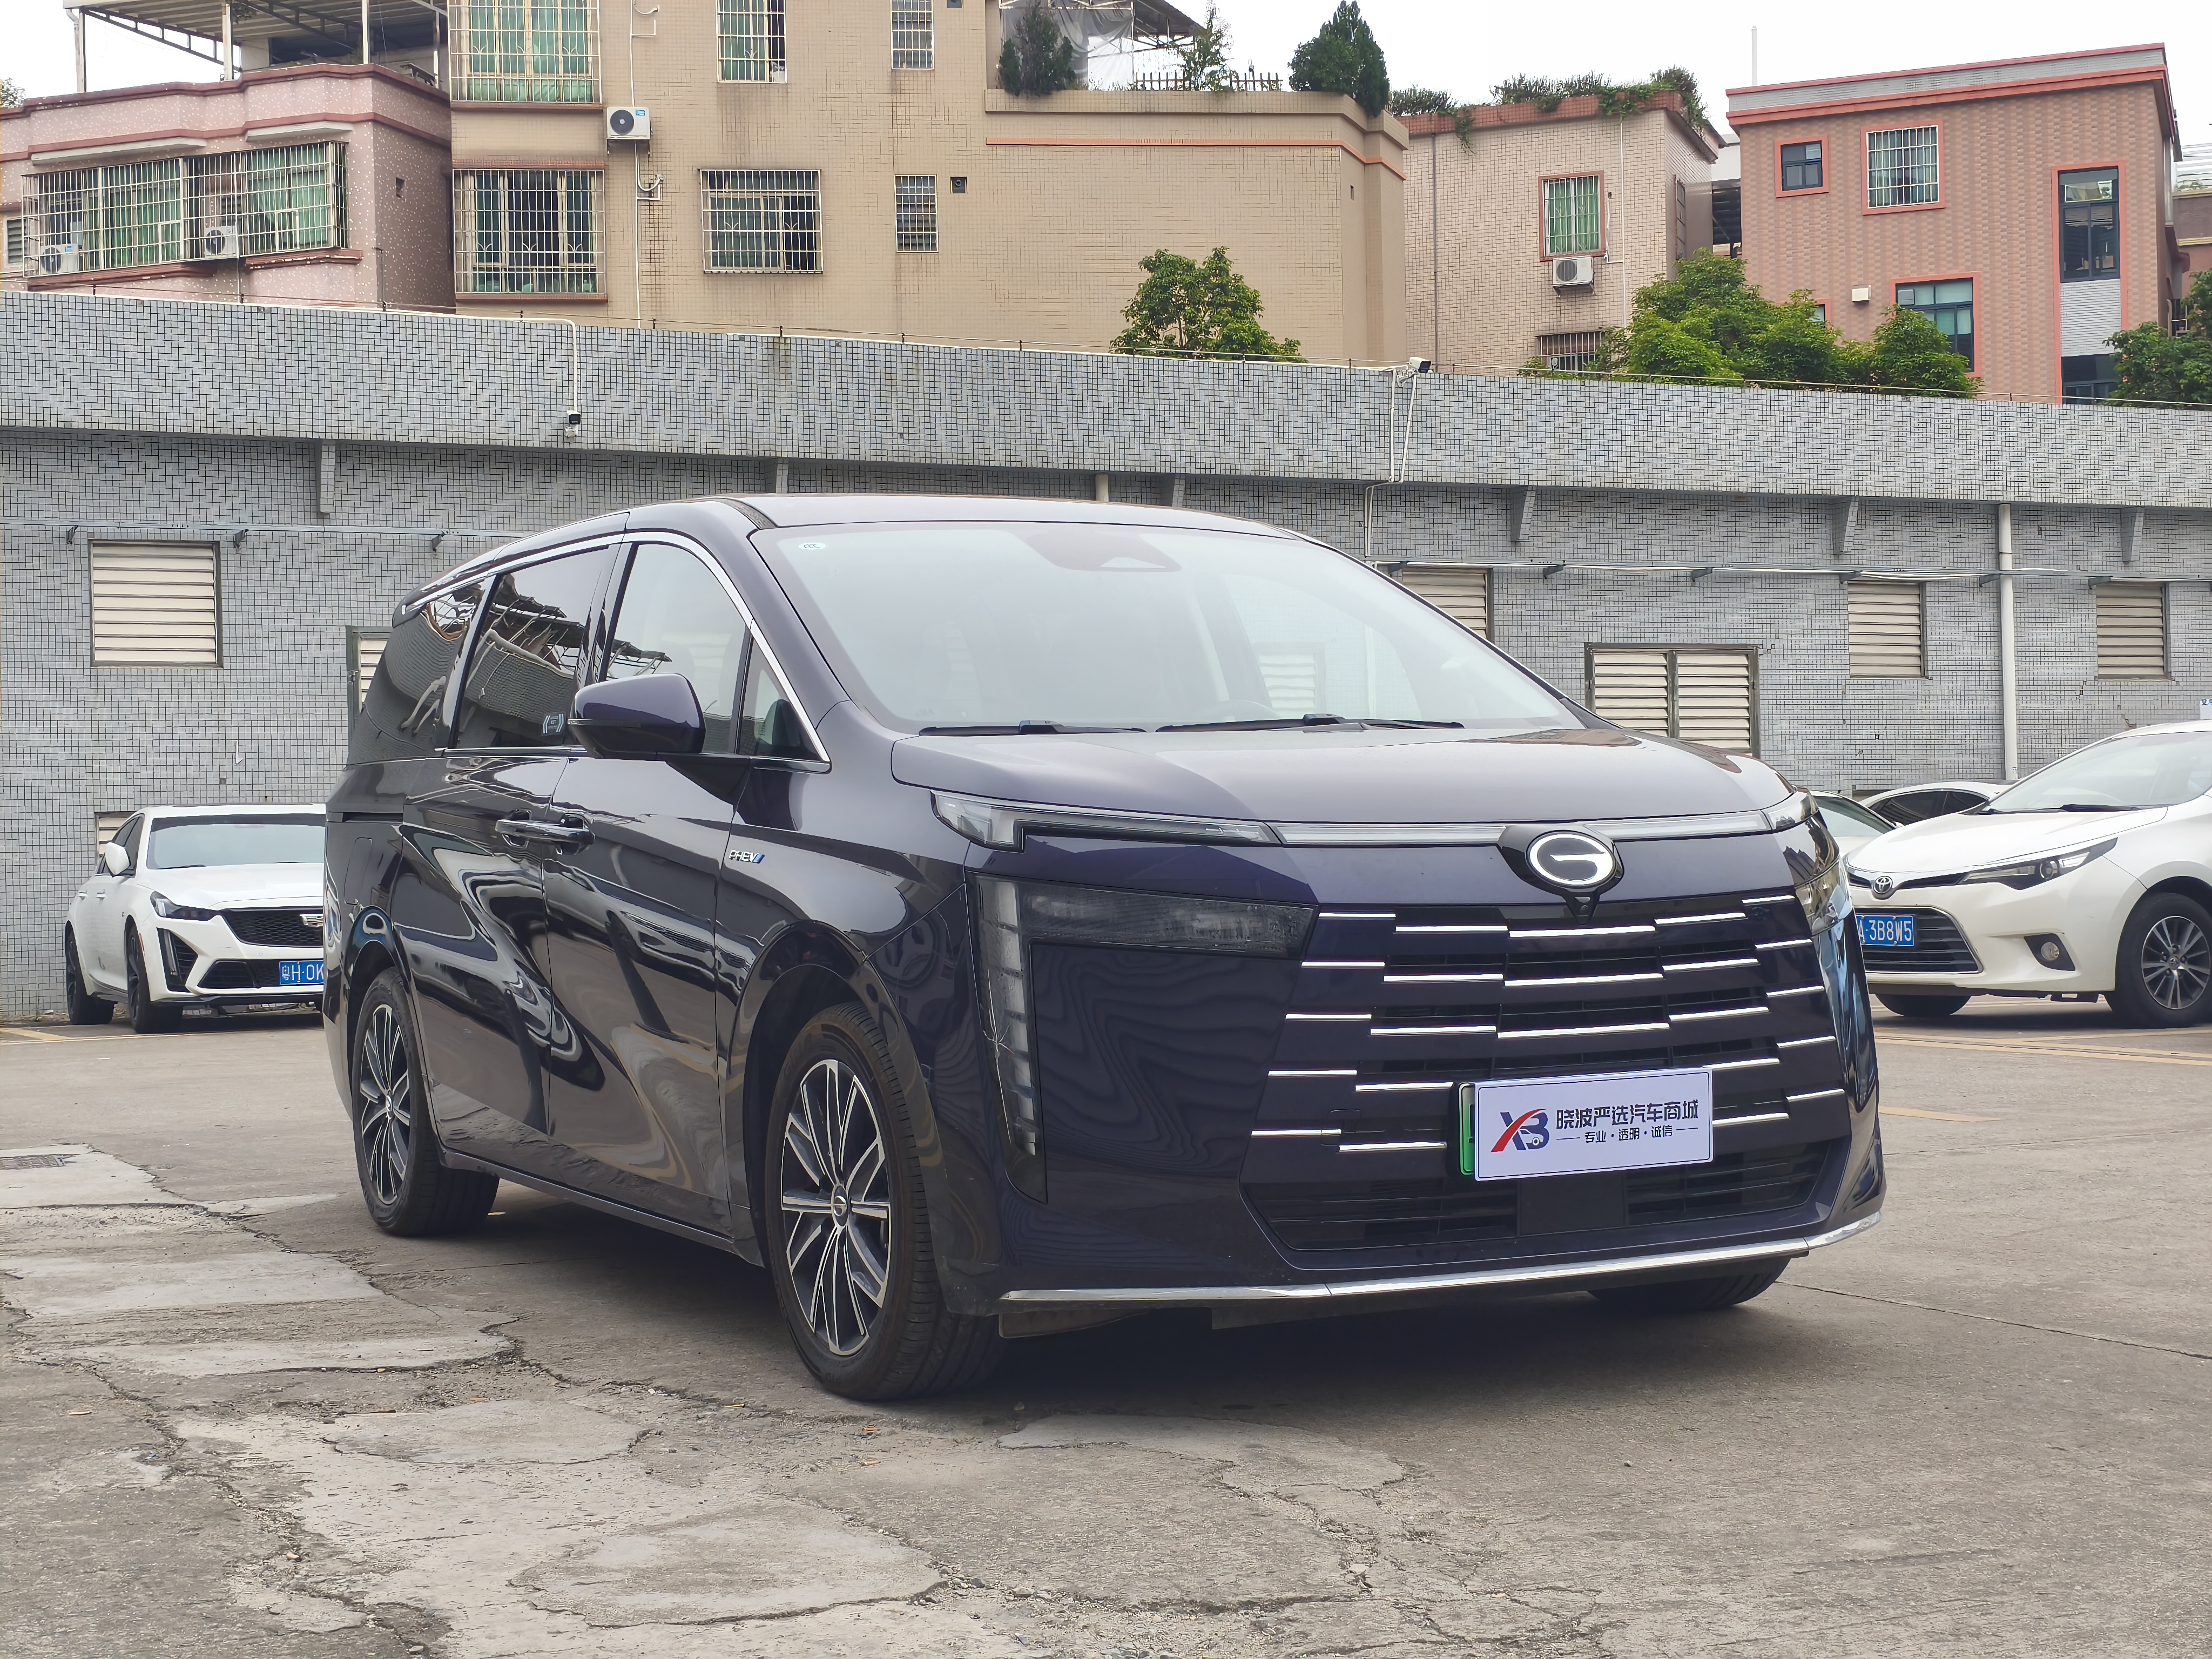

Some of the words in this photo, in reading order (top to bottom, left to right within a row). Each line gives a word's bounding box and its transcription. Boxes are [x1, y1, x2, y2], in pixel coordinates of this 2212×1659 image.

[729, 849, 759, 863] PHEV
[1556, 1100, 1698, 1130] 晓波严选汽车商城
